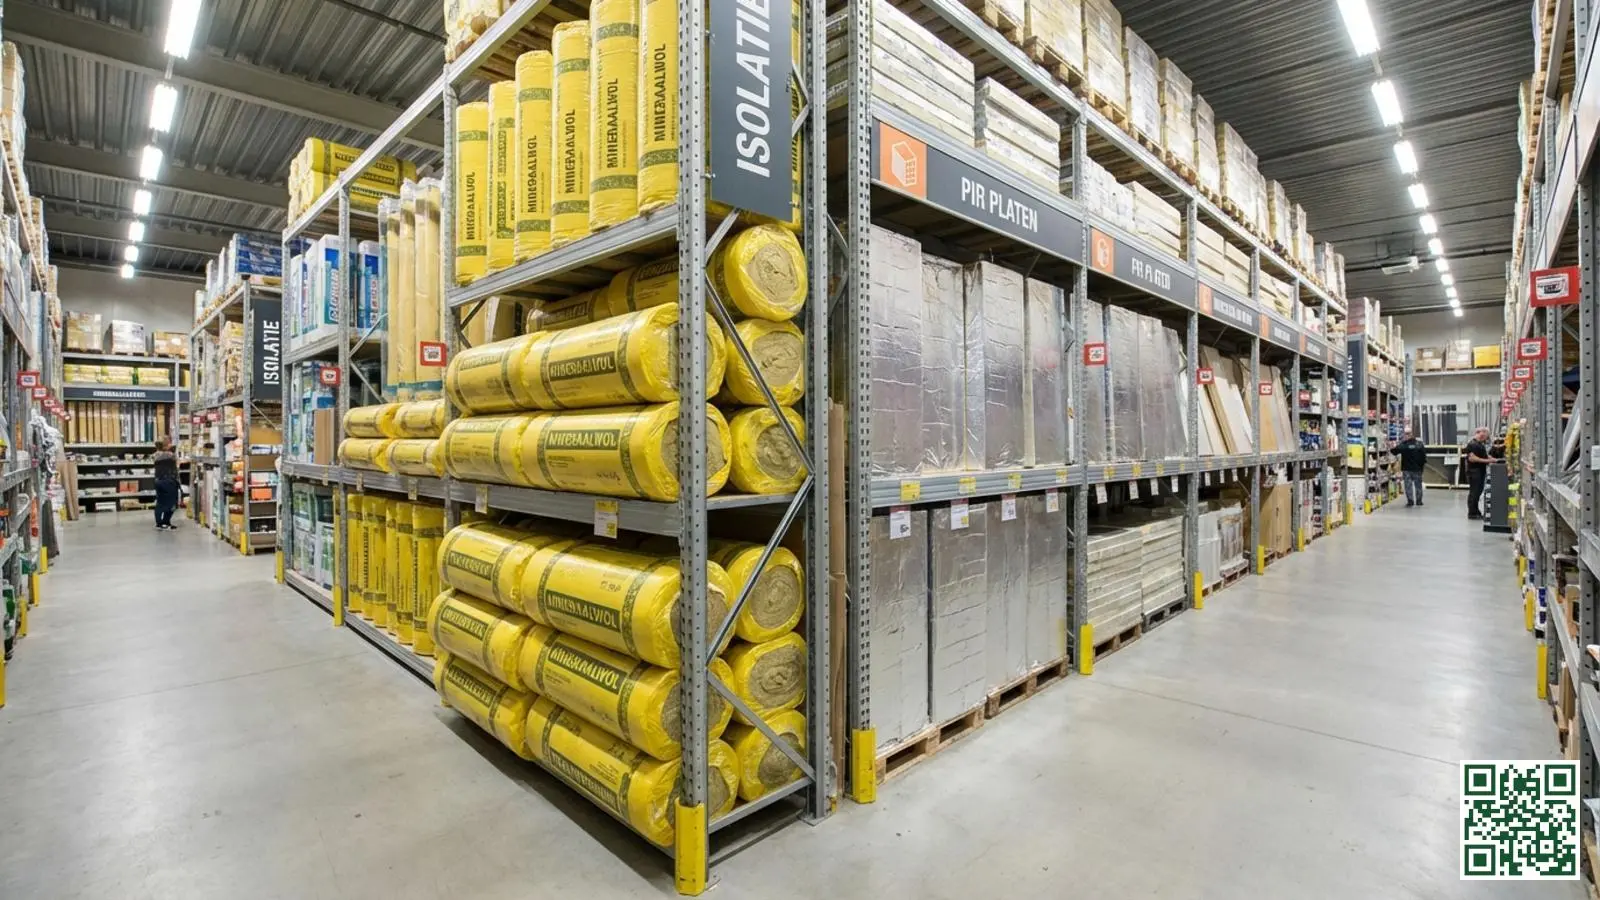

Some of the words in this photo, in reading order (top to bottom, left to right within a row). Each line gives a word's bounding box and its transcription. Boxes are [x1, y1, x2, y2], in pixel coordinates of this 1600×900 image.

[736, 0, 770, 178] ISOLATIE
[961, 177, 985, 210] PIR
[989, 190, 1038, 233] PLATEN
